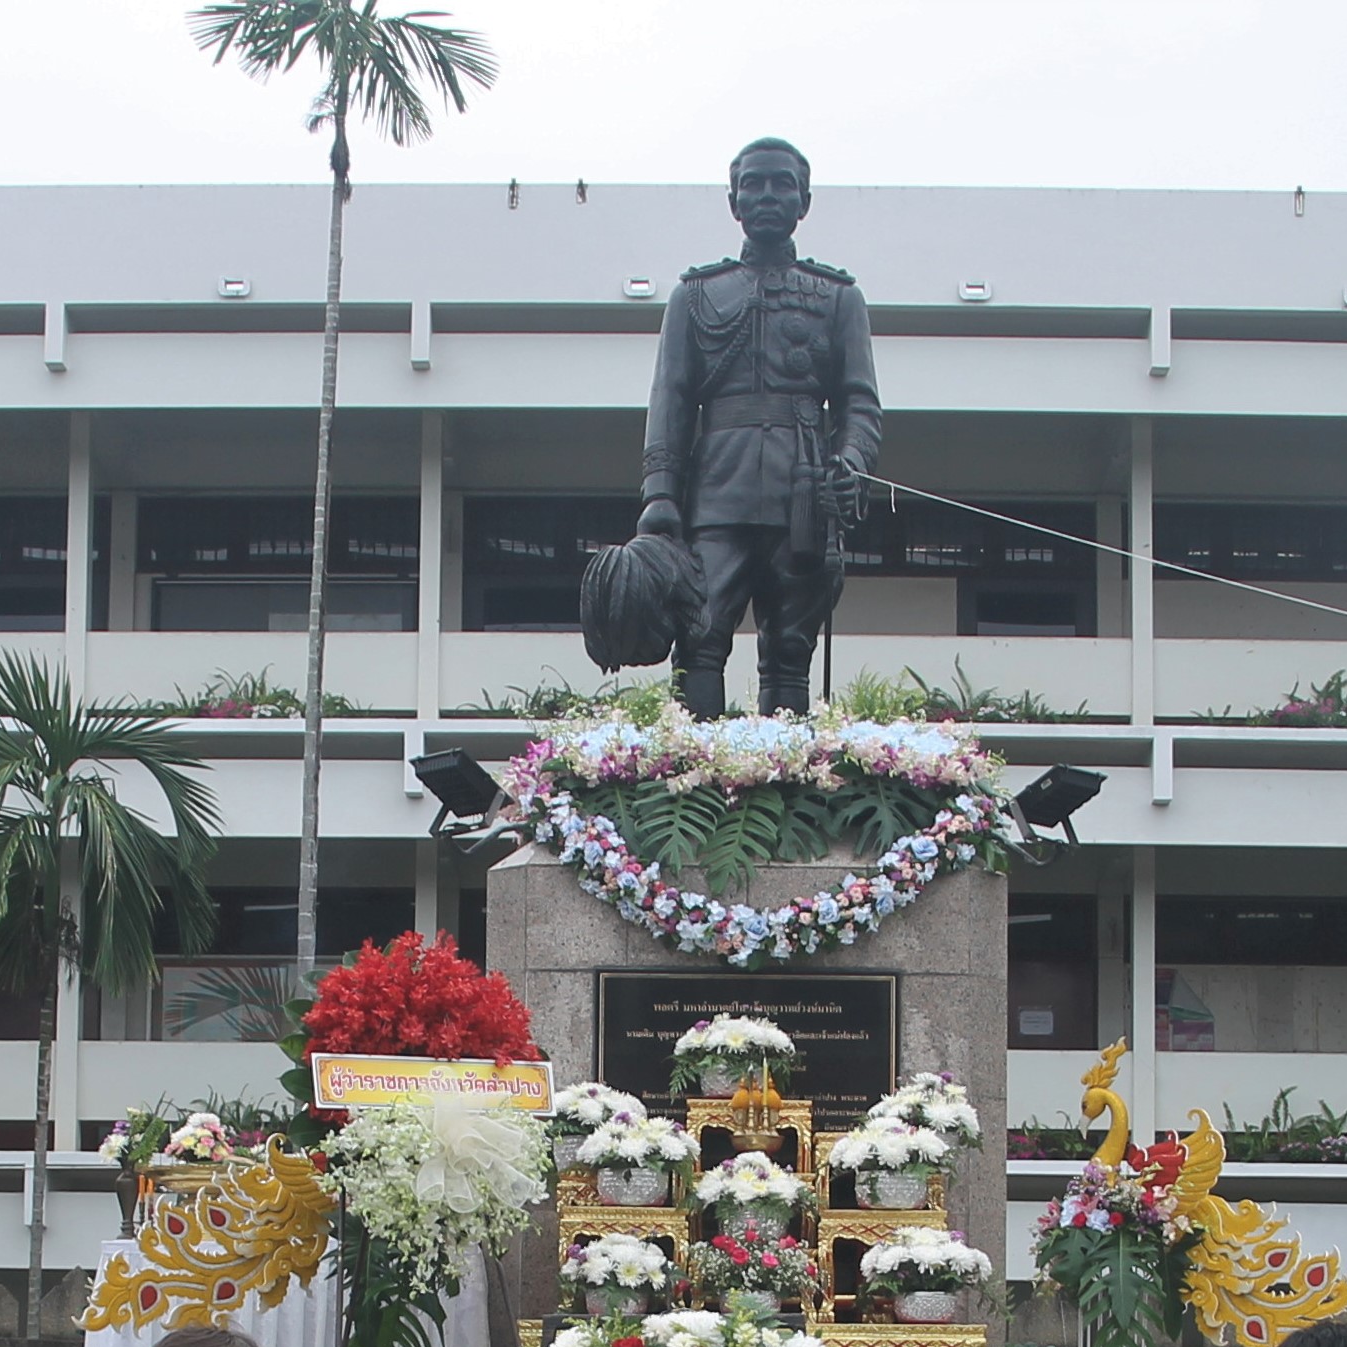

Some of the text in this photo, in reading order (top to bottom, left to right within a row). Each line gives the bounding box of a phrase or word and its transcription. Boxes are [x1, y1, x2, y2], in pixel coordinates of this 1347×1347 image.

[330, 1065, 543, 1098] ผู้ว่าราชการจังหวัดลำปาง
